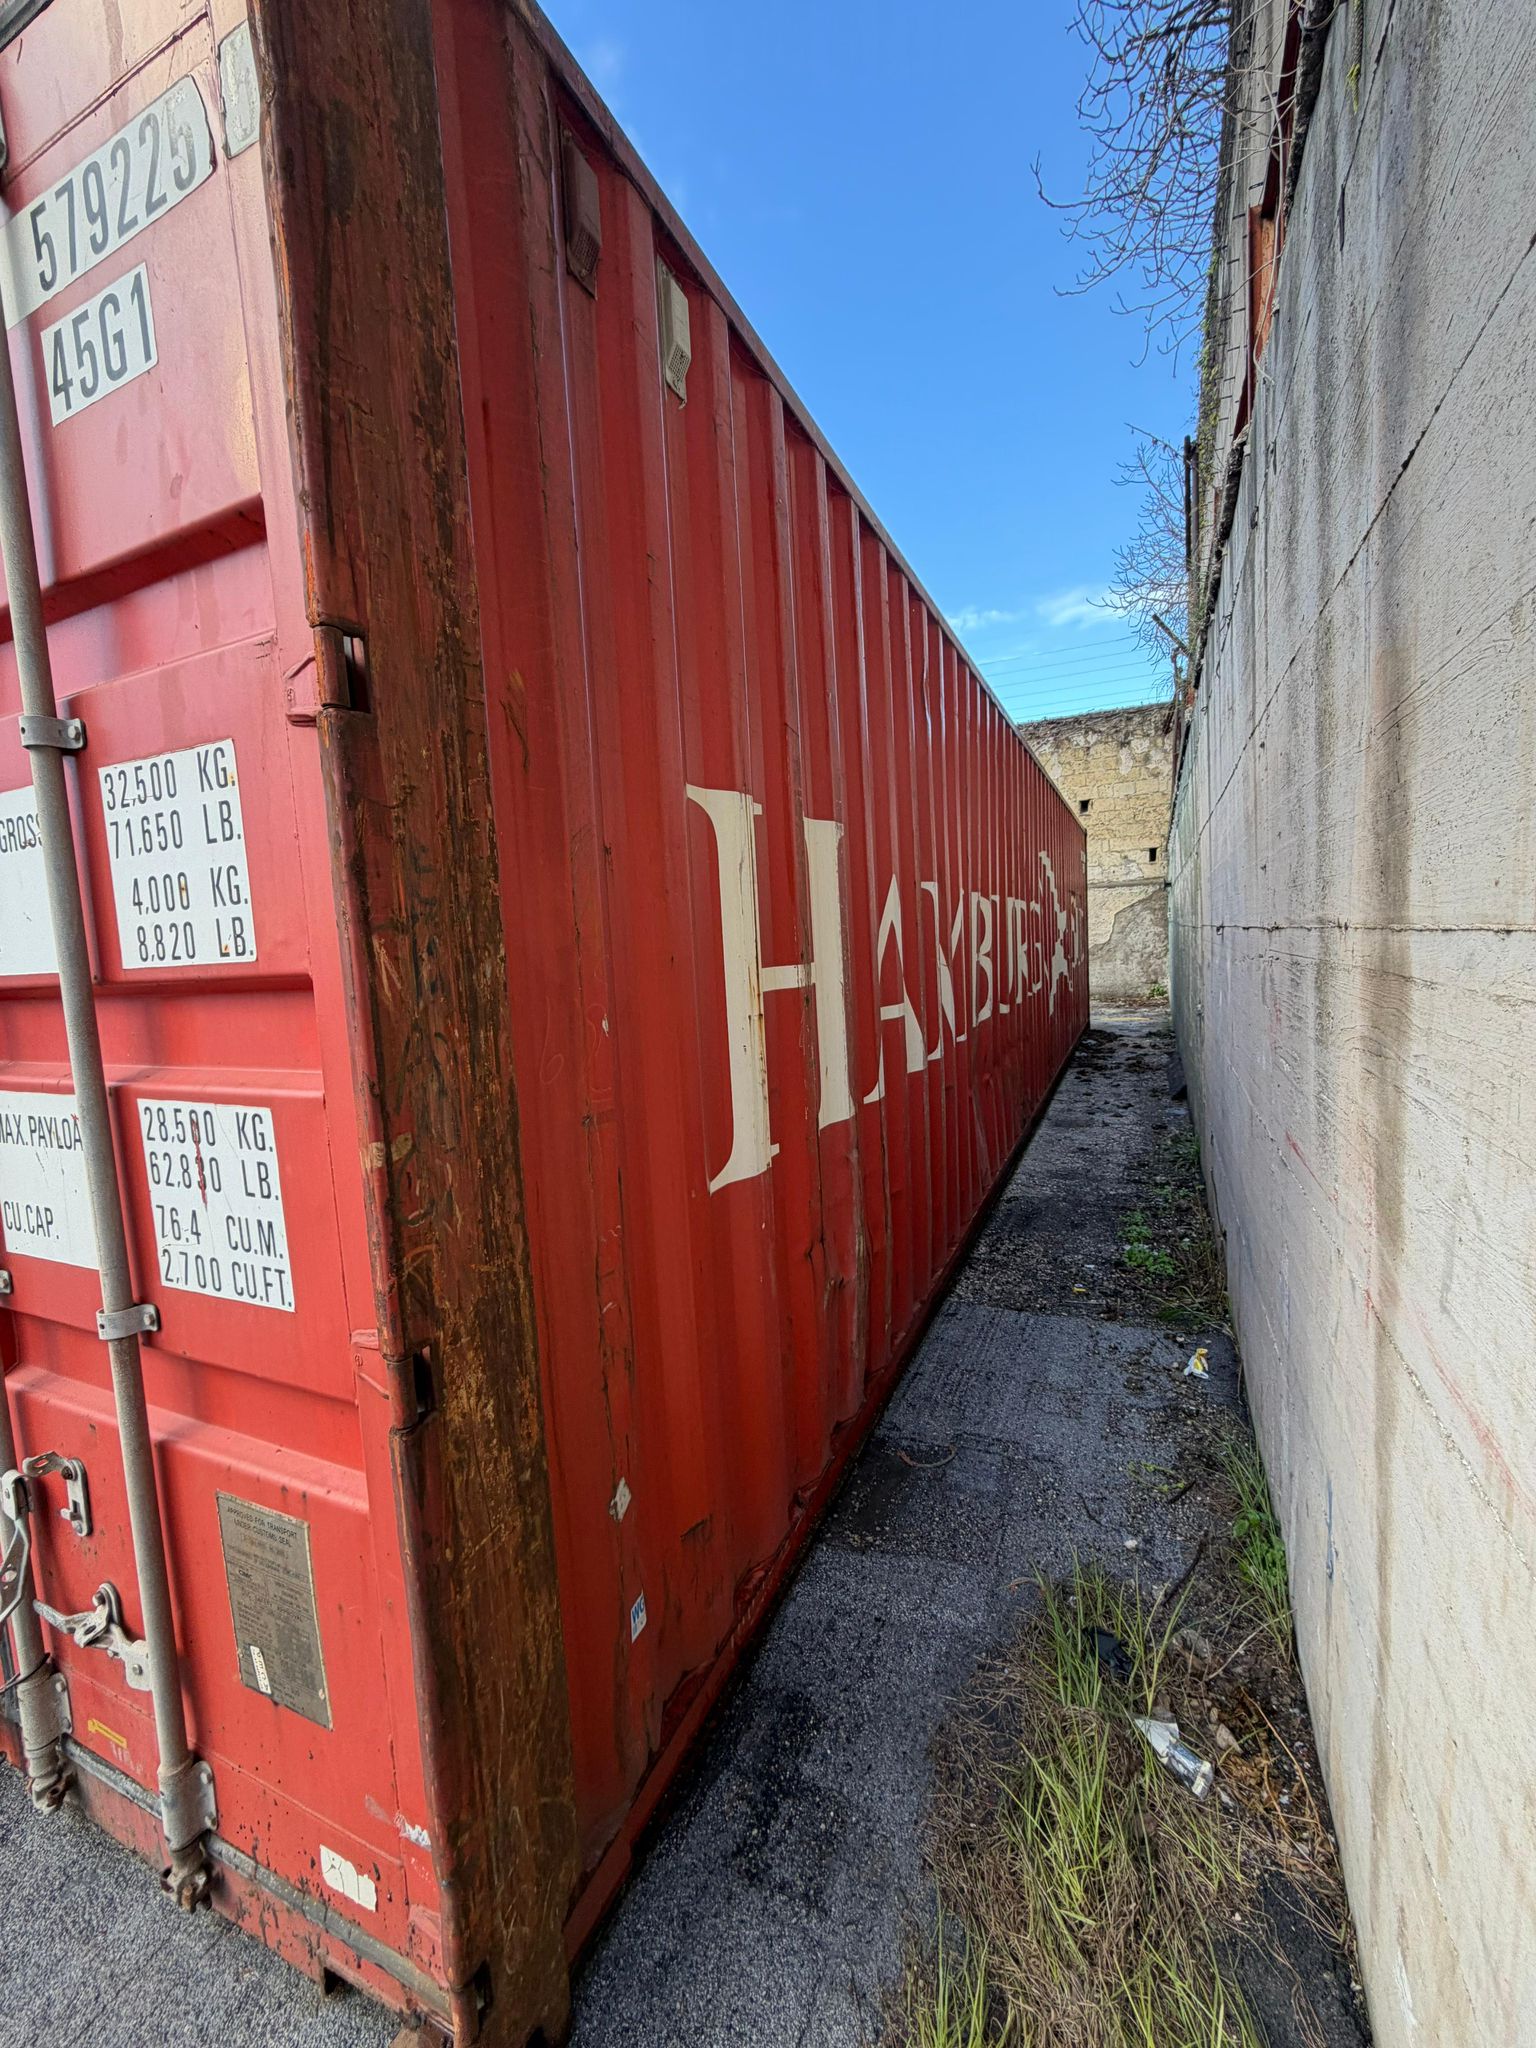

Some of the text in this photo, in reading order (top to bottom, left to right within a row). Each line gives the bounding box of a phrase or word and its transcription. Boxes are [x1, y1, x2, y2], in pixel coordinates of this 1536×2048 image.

[30, 86, 197, 292] 579225
[52, 271, 153, 411] 45G1
[104, 747, 236, 811] 32,500 KG.
[110, 800, 242, 859] 71,650 LB.
[132, 865, 249, 916] 4,000 KG.
[137, 917, 254, 962] 8,820 LB.
[144, 1107, 274, 1152] 28,500 KG.
[242, 1159, 280, 1201] LB.
[155, 1204, 285, 1260] 76.4 CU.M.
[161, 1249, 293, 1308] 2,700 CU.FT.
[267, 1521, 297, 1539] TRANSPORT
